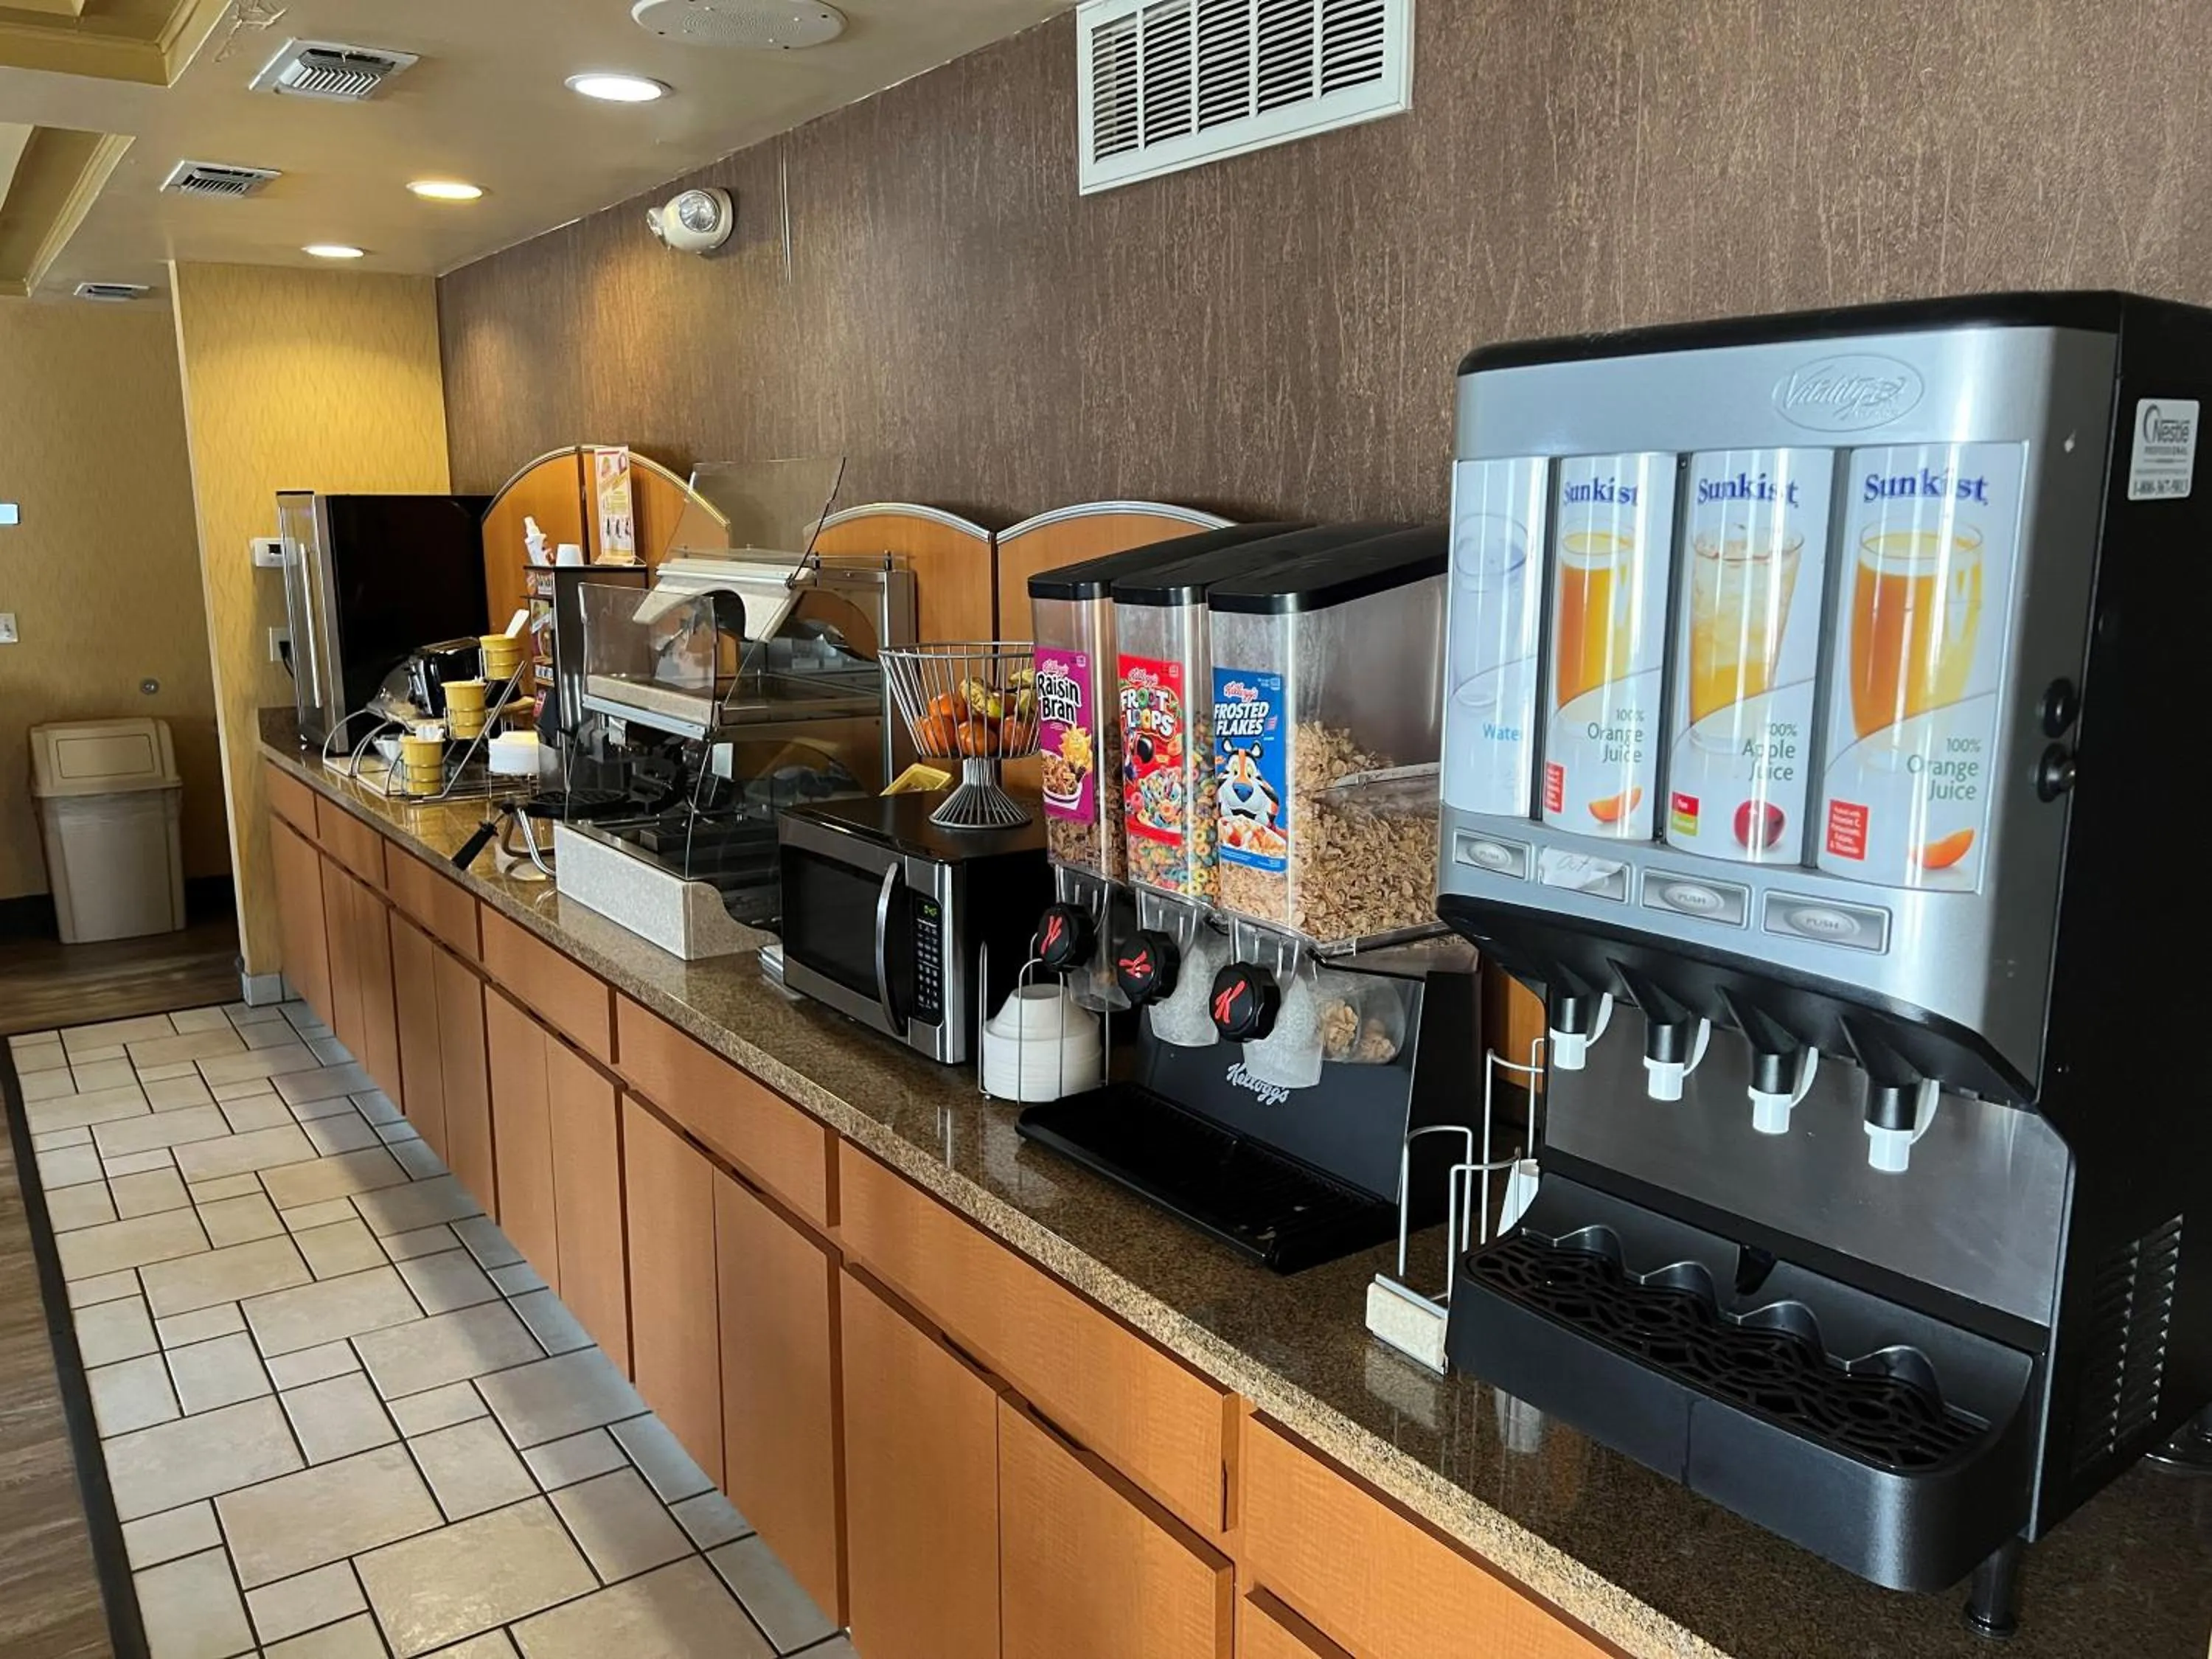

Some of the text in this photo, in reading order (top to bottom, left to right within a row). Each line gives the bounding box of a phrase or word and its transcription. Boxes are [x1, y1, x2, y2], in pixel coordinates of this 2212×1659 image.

[1697, 473, 1798, 507] Sunkist
[1863, 467, 1989, 504] Sunkist
[1037, 672, 1080, 706] Raisin
[1120, 688, 1169, 712] FROOT
[1042, 697, 1076, 723] Bran
[1214, 702, 1270, 720] FROSTED
[1126, 708, 1175, 737] LOOPS
[1216, 718, 1264, 736] FLAKES
[1482, 723, 1522, 741] Wate
[1587, 721, 1645, 748] Orange
[1769, 722, 1798, 738] 00%
[1601, 743, 1643, 764] Juice
[1741, 737, 1797, 765] Apple
[1946, 738, 1982, 753] 100%
[1906, 754, 1979, 783] Orange
[1927, 778, 1978, 801] Juice
[1806, 917, 1840, 931] PUSH
